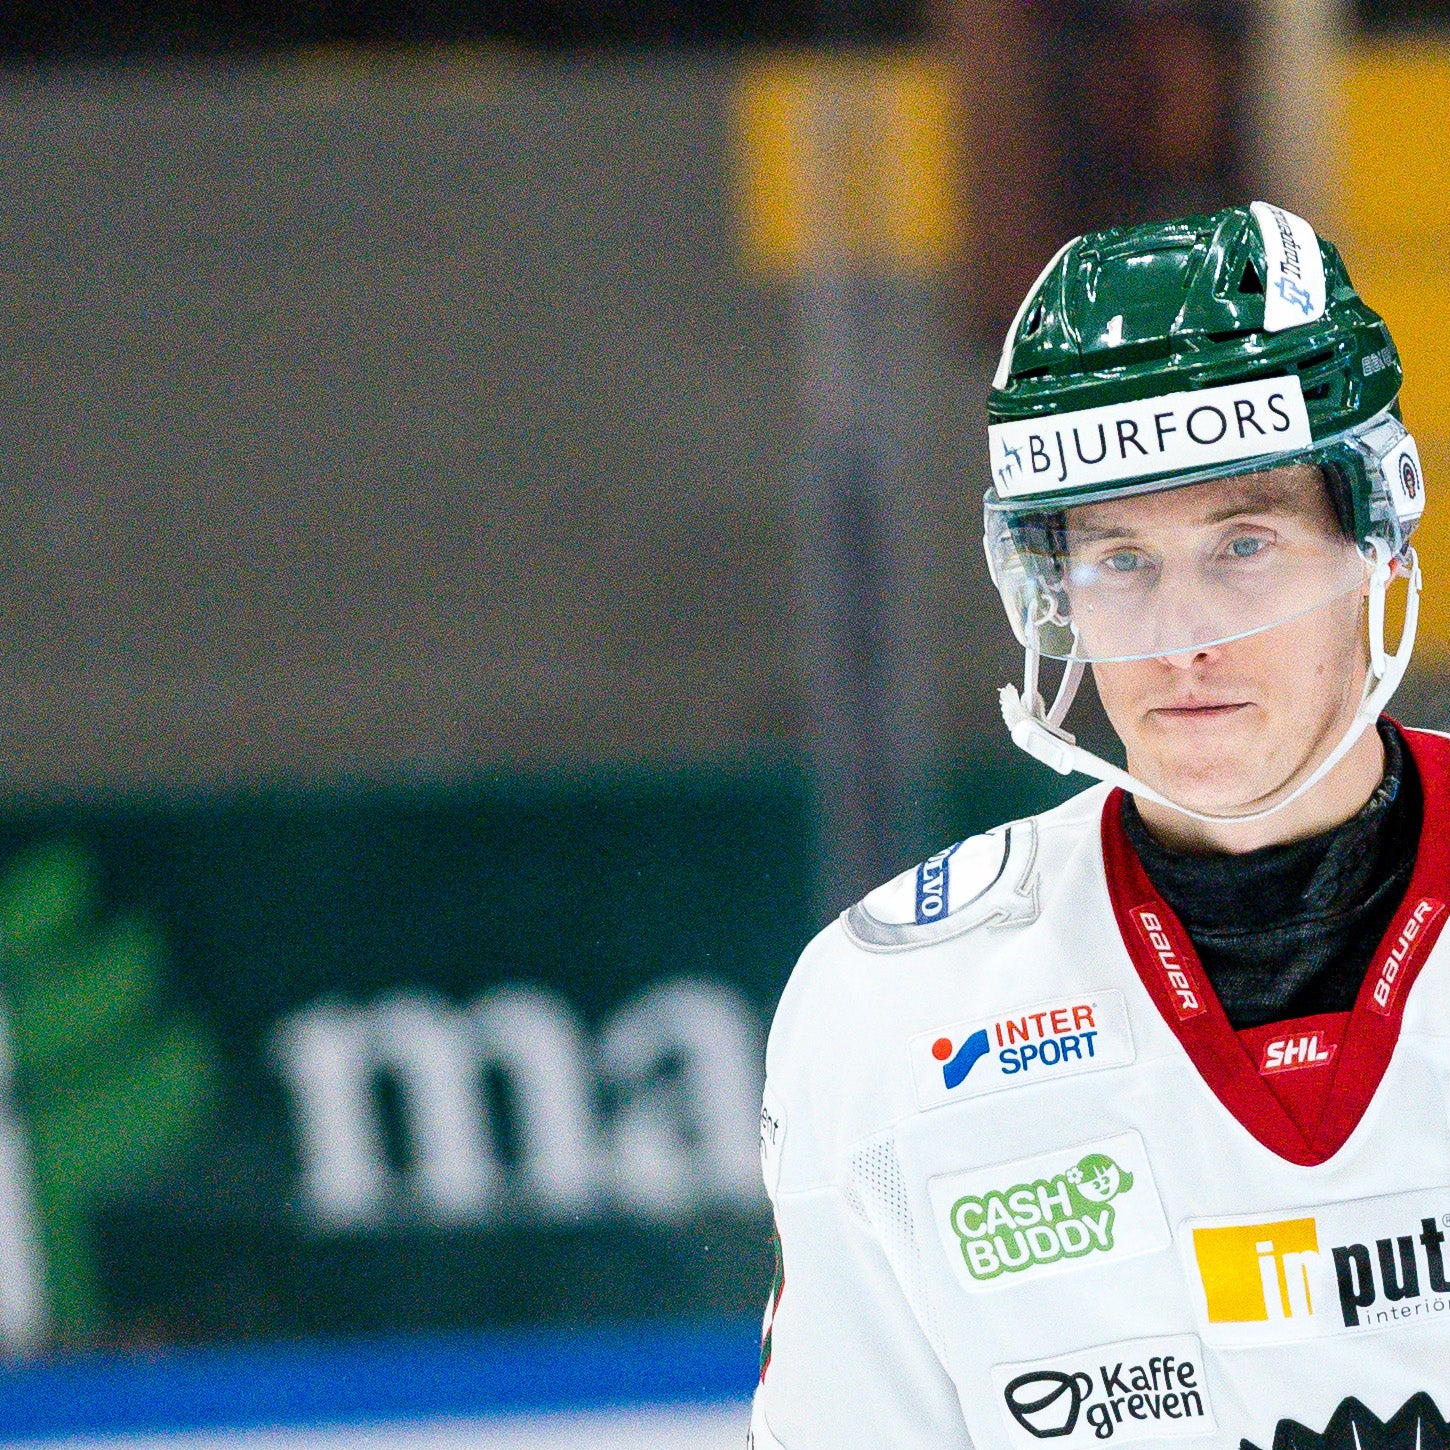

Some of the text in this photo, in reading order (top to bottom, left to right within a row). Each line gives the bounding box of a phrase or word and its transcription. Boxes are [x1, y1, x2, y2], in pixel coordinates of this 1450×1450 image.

[1029, 393, 1291, 482] BJURFORS
[1140, 912, 1199, 1009] BAUER
[1373, 901, 1432, 1007] BAUER
[995, 1004, 1096, 1047] INTER
[1265, 1035, 1328, 1068] SHL
[999, 1031, 1098, 1074] SPORT
[956, 1180, 1073, 1238] CASH
[966, 1210, 1110, 1275] BUDDY
[1100, 1356, 1197, 1397] Kaffe
[1086, 1390, 1204, 1439] greven
